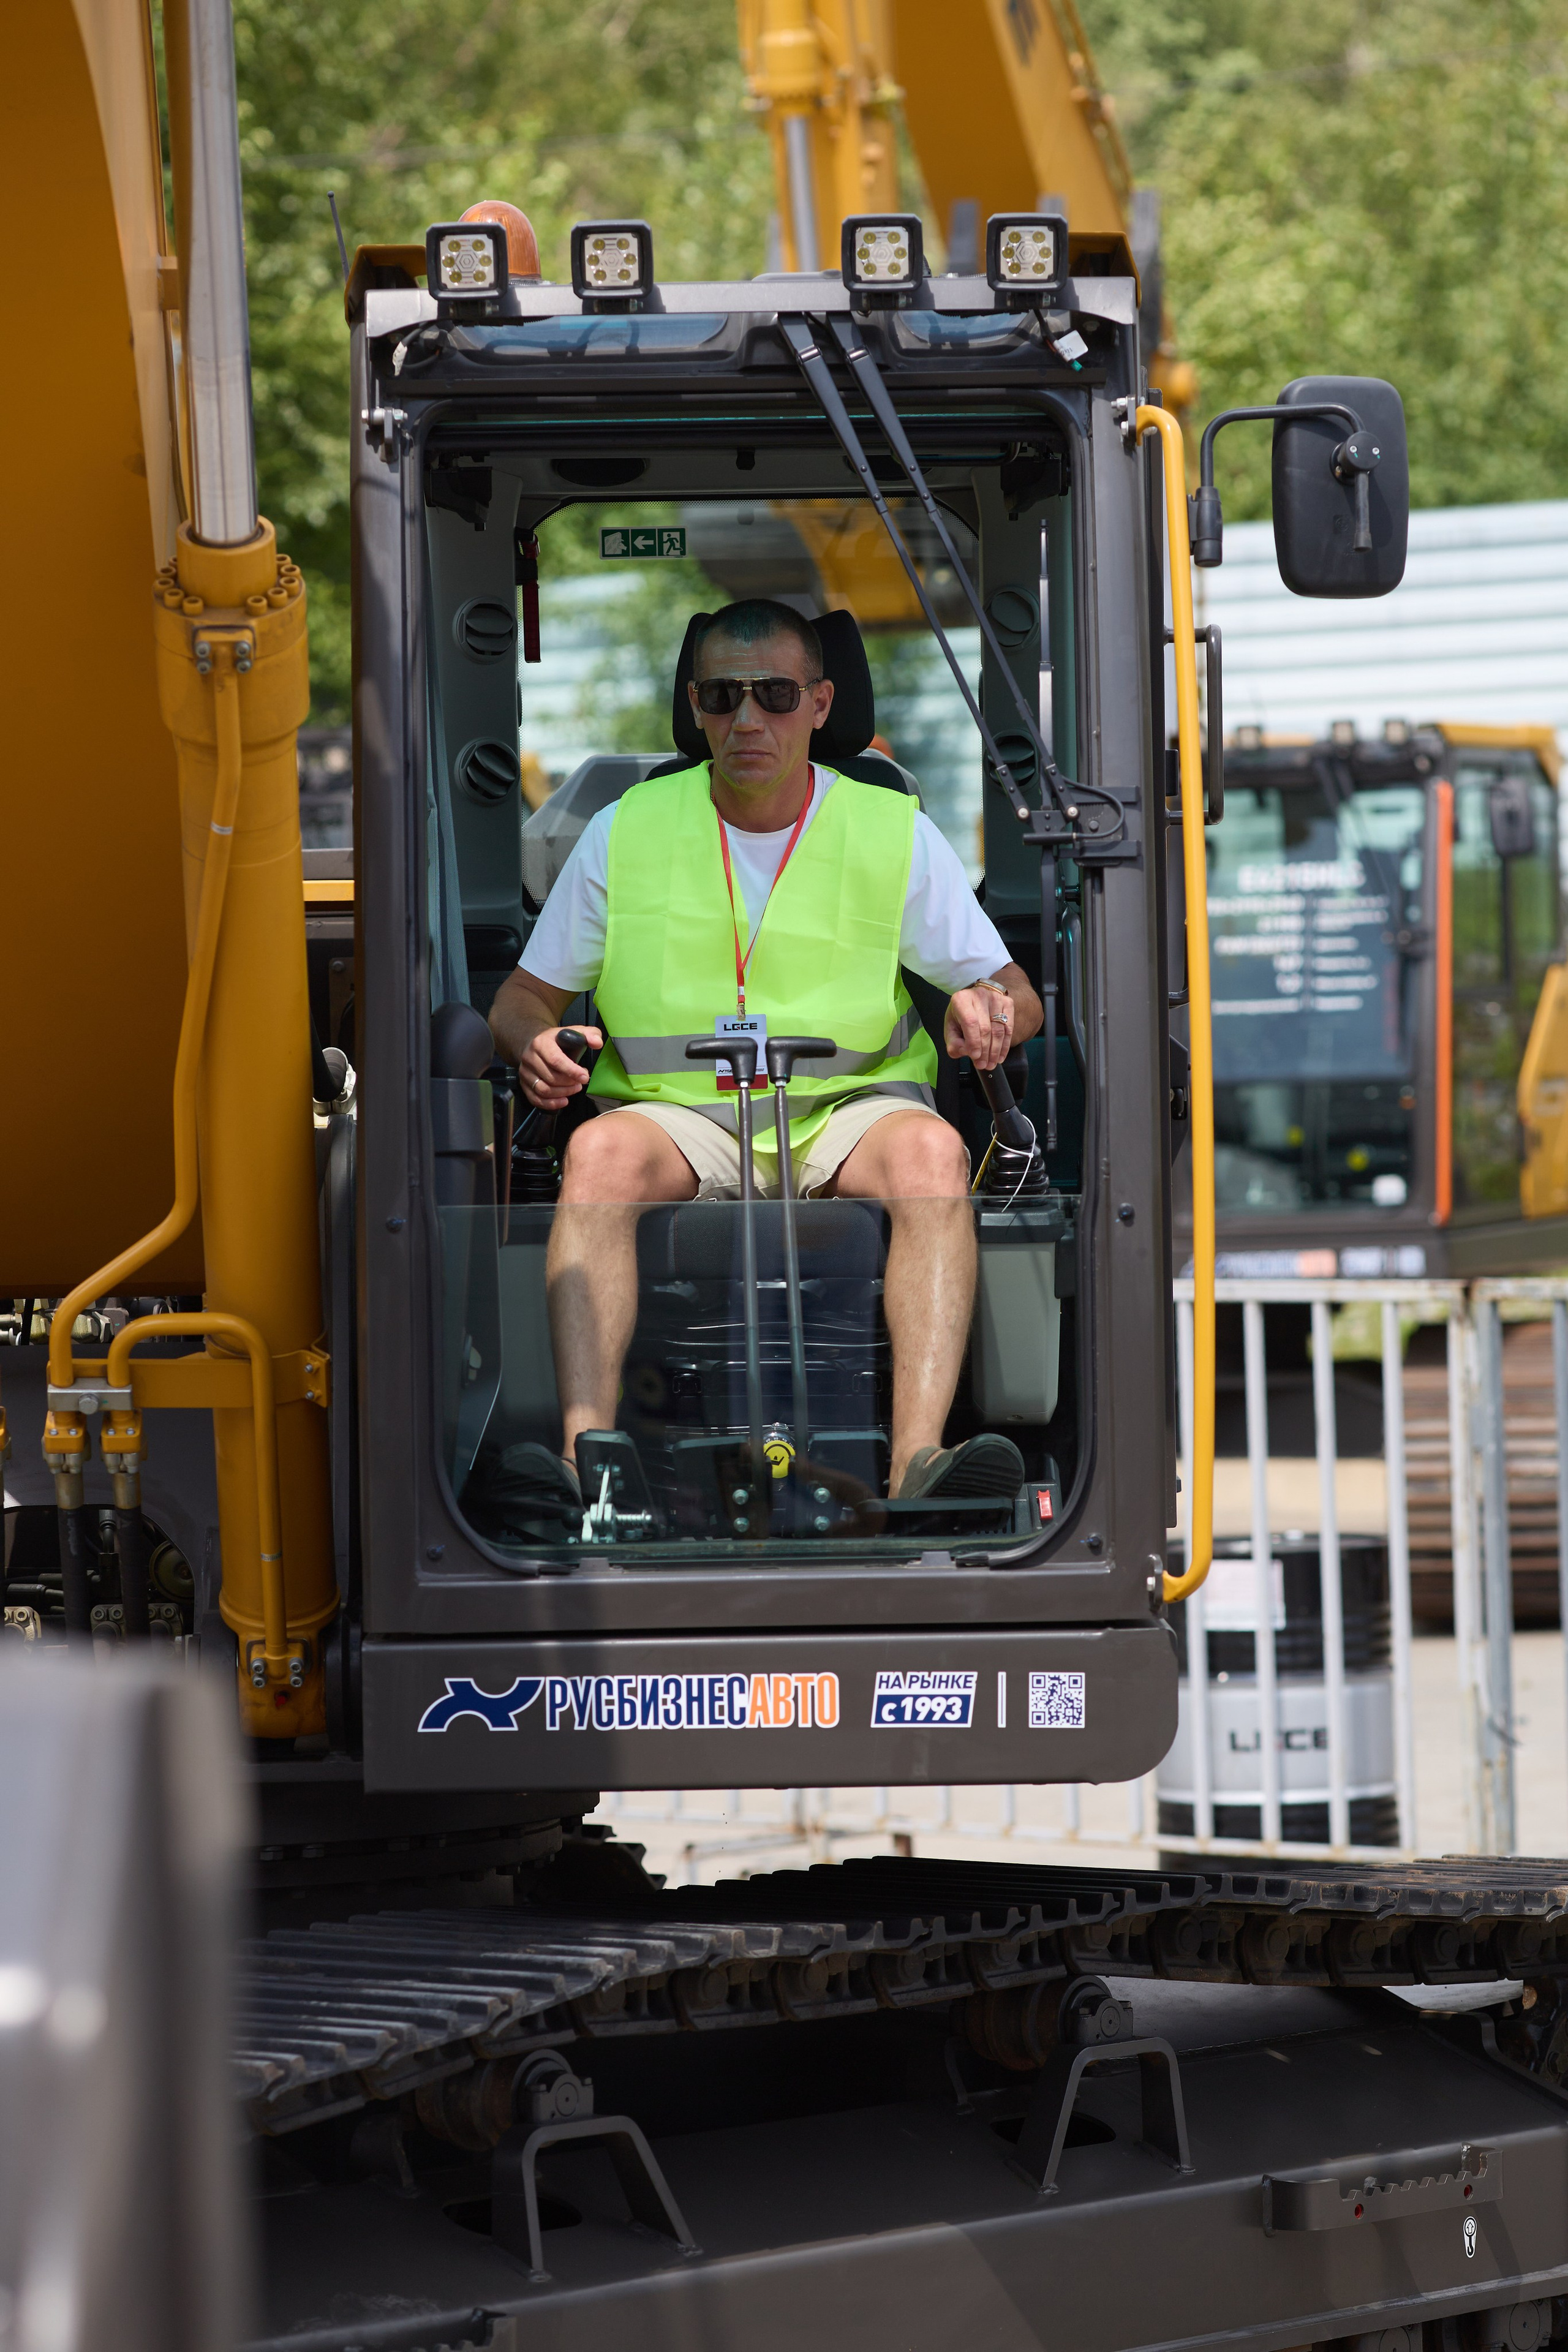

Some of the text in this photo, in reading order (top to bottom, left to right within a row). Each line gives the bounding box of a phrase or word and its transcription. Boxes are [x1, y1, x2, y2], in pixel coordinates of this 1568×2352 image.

[878, 1675, 974, 1689] НА РЫНКЕ
[547, 1673, 839, 1730] РУСБИЗНЕСАВТО
[900, 1696, 963, 1721] 1993
[1229, 1727, 1328, 1751] LCE
